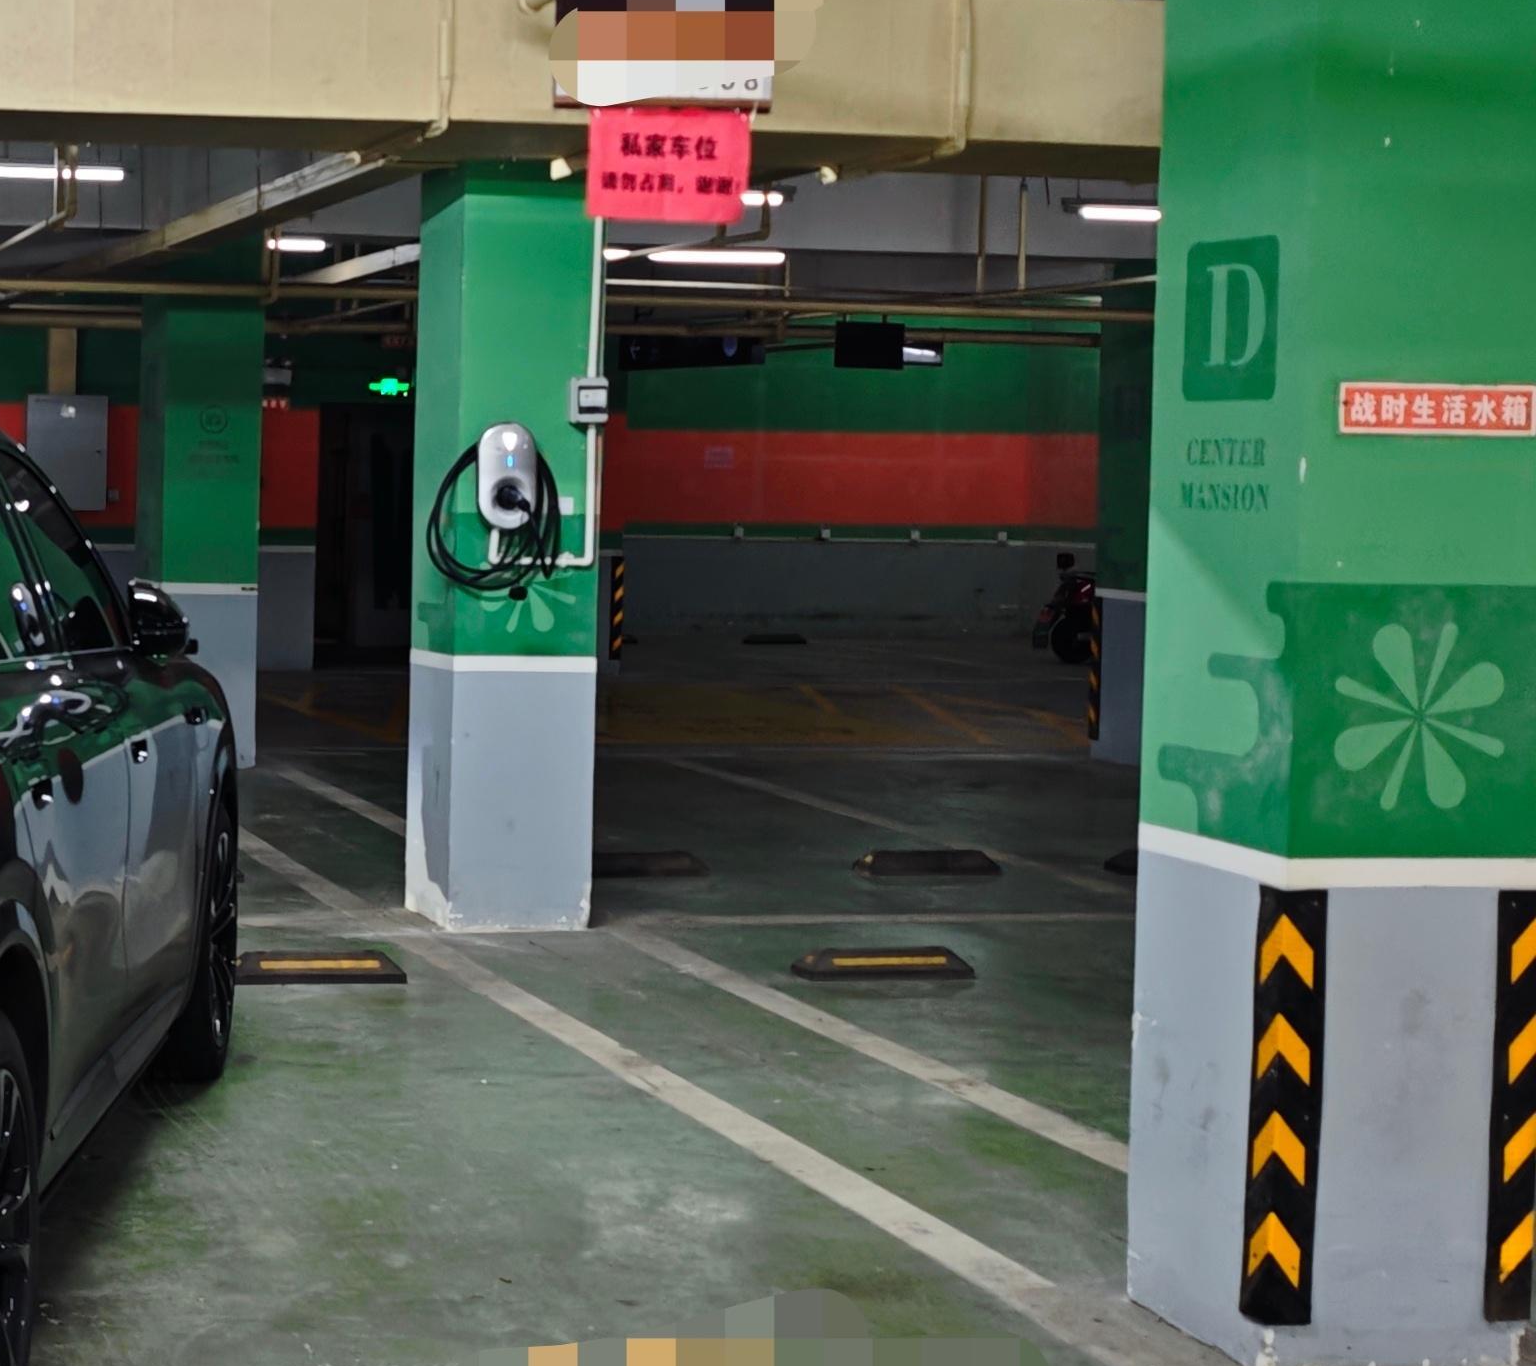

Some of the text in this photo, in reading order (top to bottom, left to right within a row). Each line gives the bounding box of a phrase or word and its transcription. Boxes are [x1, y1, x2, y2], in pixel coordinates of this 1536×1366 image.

[620, 132, 718, 161] 私家车位
[1206, 263, 1267, 368] D
[1350, 391, 1528, 427] 战时生活水箱
[1187, 437, 1267, 468] CENTER
[1180, 481, 1270, 512] MANSION
